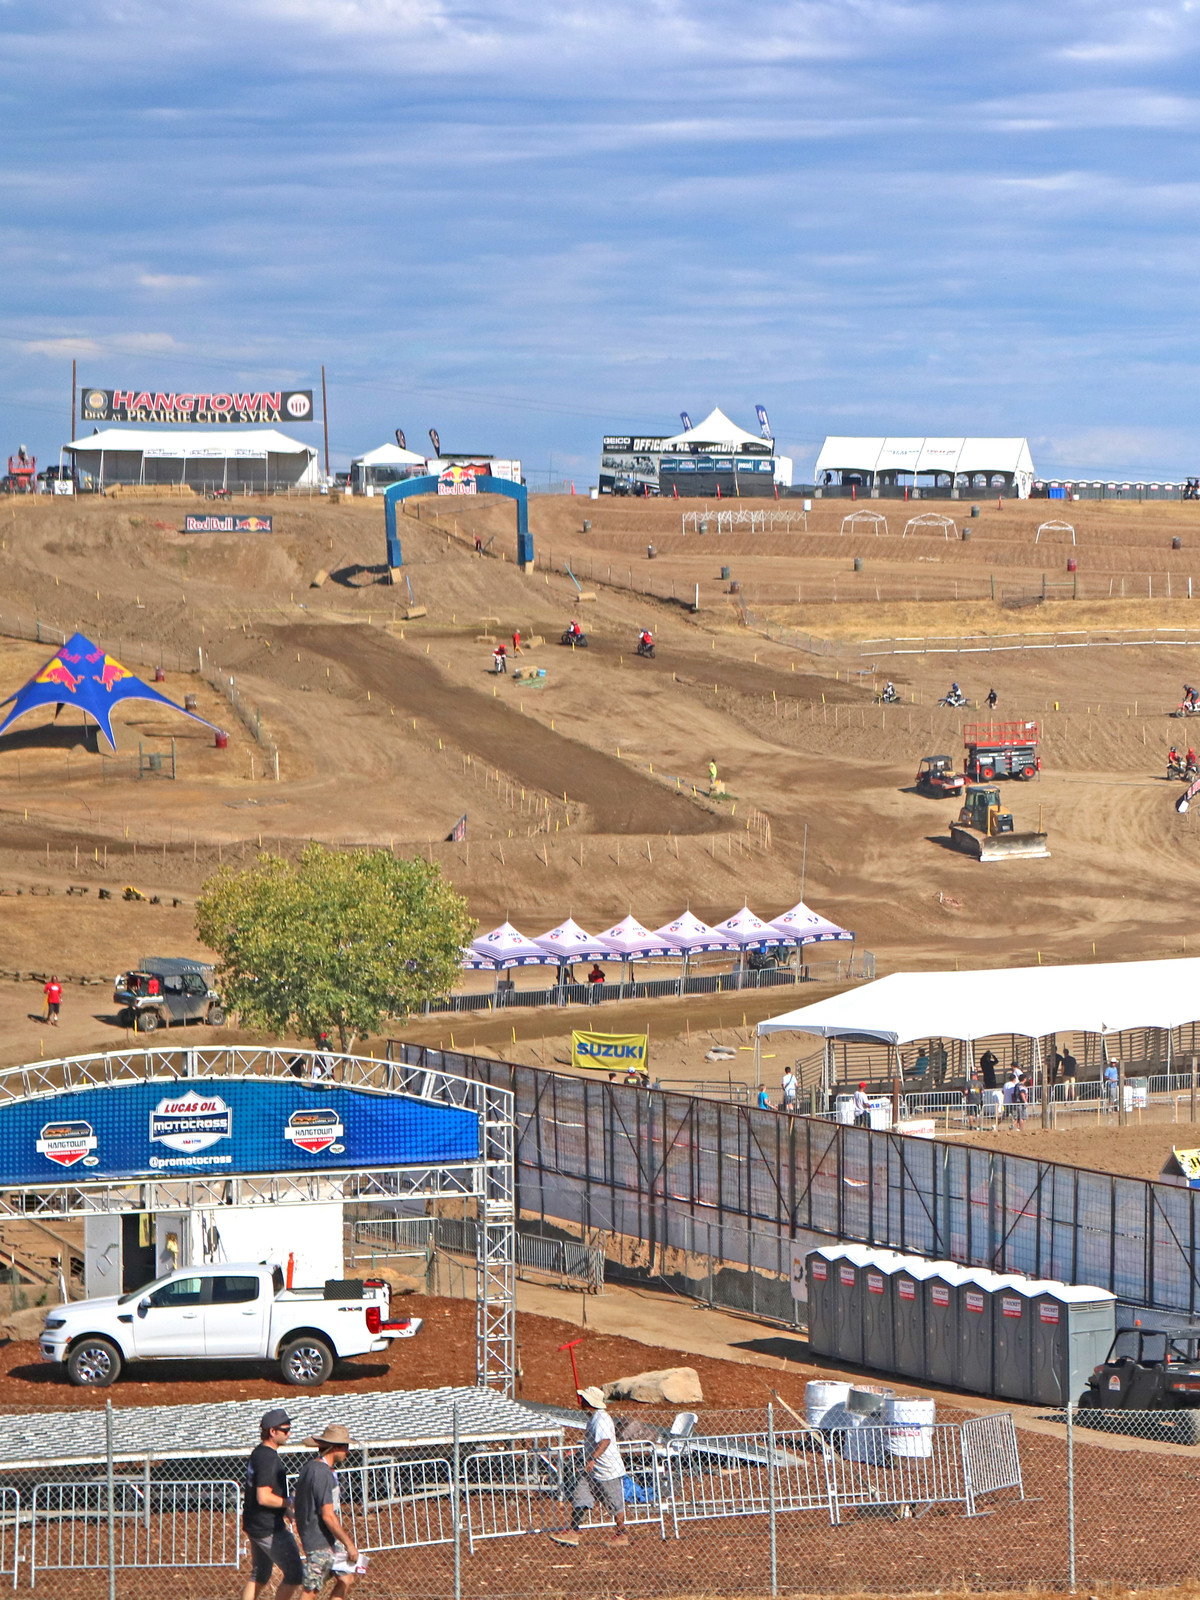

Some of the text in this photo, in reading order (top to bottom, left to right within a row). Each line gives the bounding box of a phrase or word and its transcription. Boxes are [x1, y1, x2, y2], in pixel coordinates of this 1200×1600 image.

[112, 389, 282, 412] HANGTOWN
[127, 409, 192, 423] PRAIRIE
[196, 410, 234, 423] CITY
[239, 409, 282, 423] SVRA
[438, 482, 477, 495] Red Bull
[186, 516, 233, 531] Red Bull
[576, 1042, 643, 1059] SUZUKI
[164, 1102, 216, 1114] LUCAS OIL
[153, 1118, 228, 1131] MOTOCROSS
[295, 1127, 333, 1136] HANGTOWN
[47, 1139, 86, 1149] HANGTOWN
[149, 1156, 232, 1169] @promotocross
